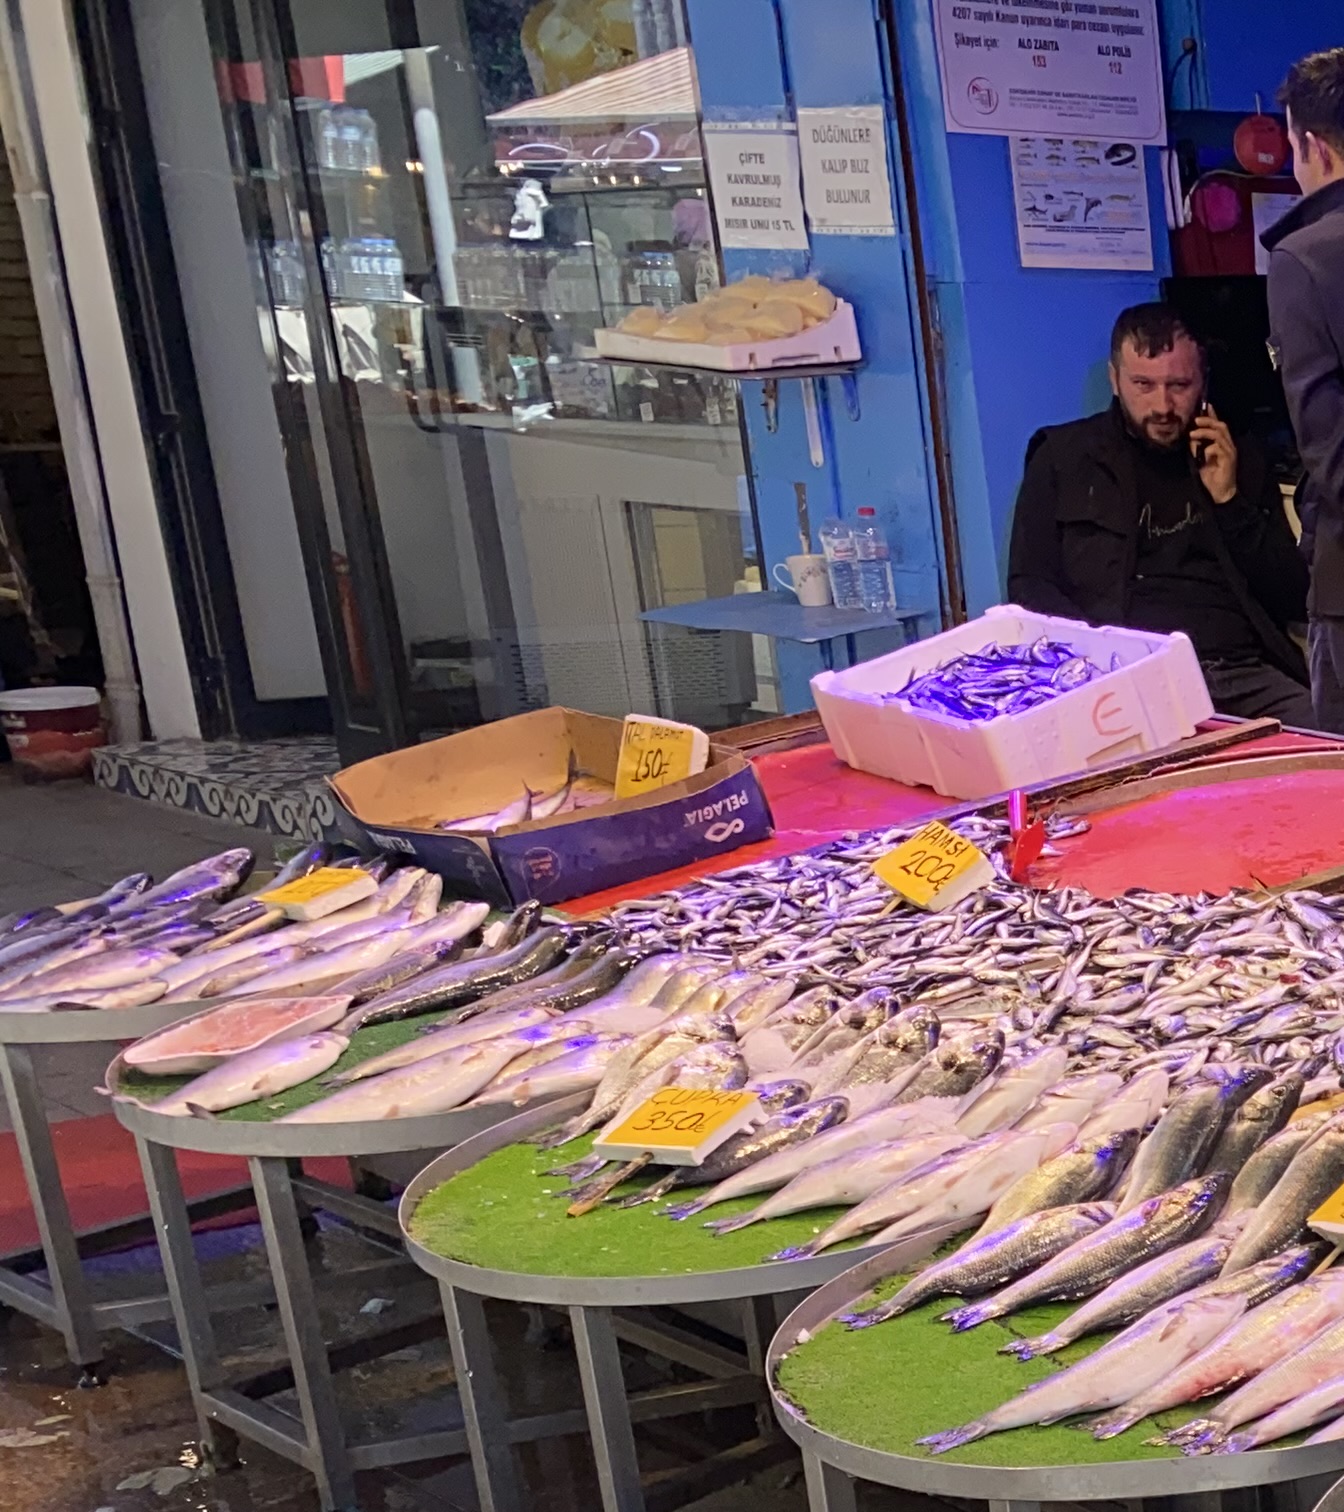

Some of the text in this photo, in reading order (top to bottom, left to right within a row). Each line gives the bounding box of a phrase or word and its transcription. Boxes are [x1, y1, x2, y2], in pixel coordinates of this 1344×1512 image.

[952, 7, 971, 22] 4207
[1032, 55, 1047, 69] 153
[812, 125, 871, 144] DÜĞÜNLERE
[738, 152, 765, 166] ÇİFTE
[821, 159, 870, 174] KALIP BUZ
[727, 173, 782, 188] KAVRULMUŞ
[731, 196, 782, 209] KARADENİZ
[826, 189, 871, 204] BULUNUR
[782, 220, 796, 231] TL
[685, 789, 749, 825] PELAGIA
